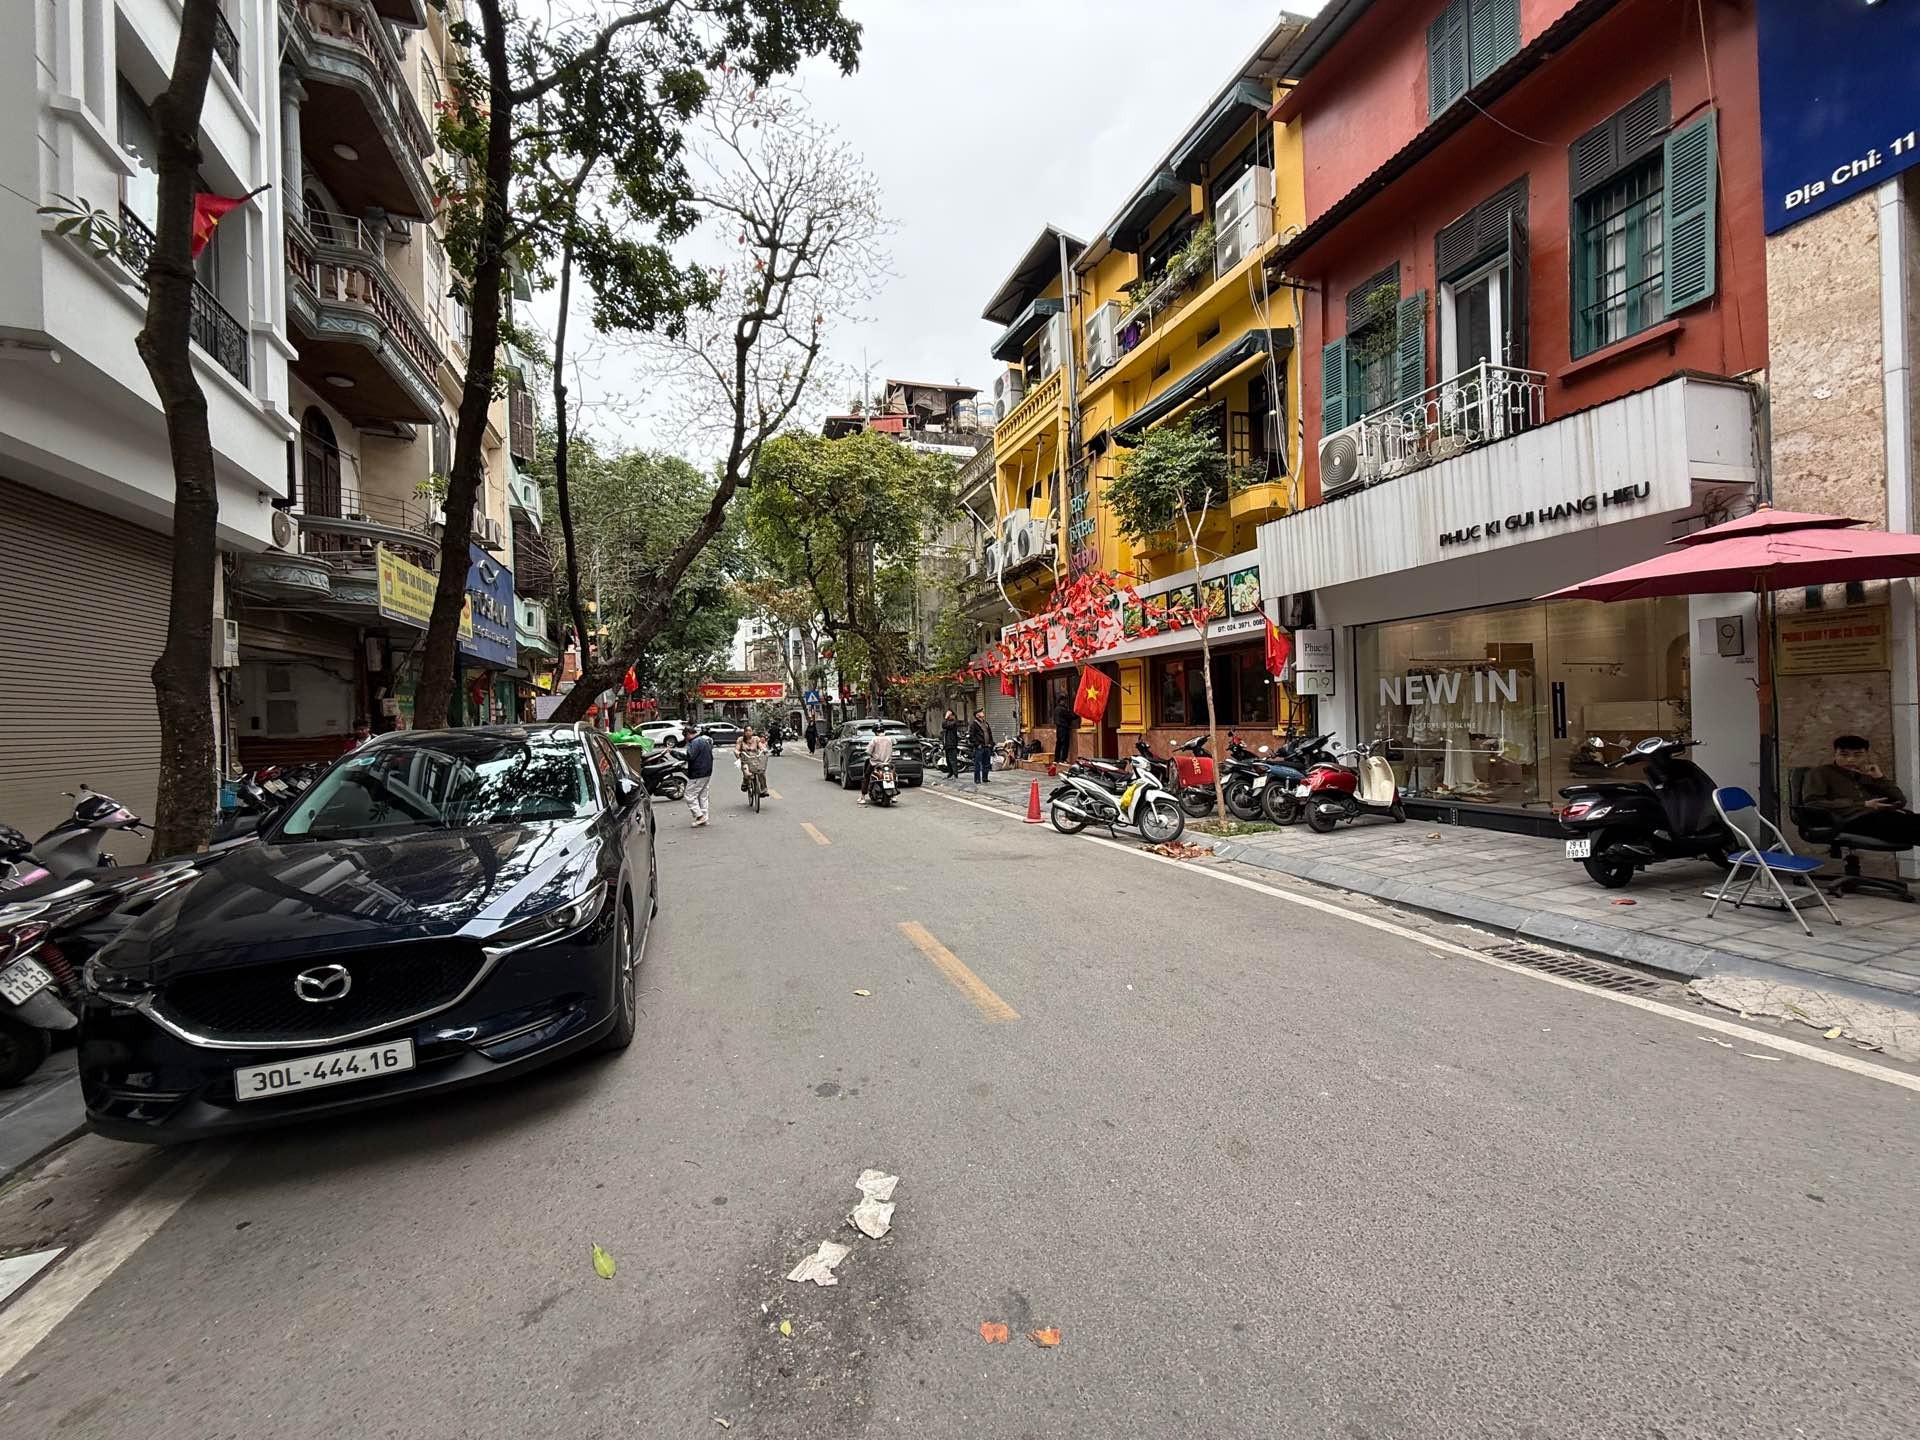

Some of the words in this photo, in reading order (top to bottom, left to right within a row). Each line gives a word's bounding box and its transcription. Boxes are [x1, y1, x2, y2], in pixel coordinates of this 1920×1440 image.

[1784, 180, 1825, 210] Địa
[1831, 148, 1882, 185] Chỉ:
[1439, 525, 1481, 547] PHUC
[1485, 520, 1500, 537] KI
[1504, 511, 1535, 530] GUI
[1538, 495, 1598, 523] HANG
[1602, 481, 1650, 508] HIEU
[1720, 623, 1735, 645] 9
[1379, 672, 1461, 706] NEW
[1474, 668, 1518, 703] IN
[252, 1048, 398, 1092] 30L-444.16
